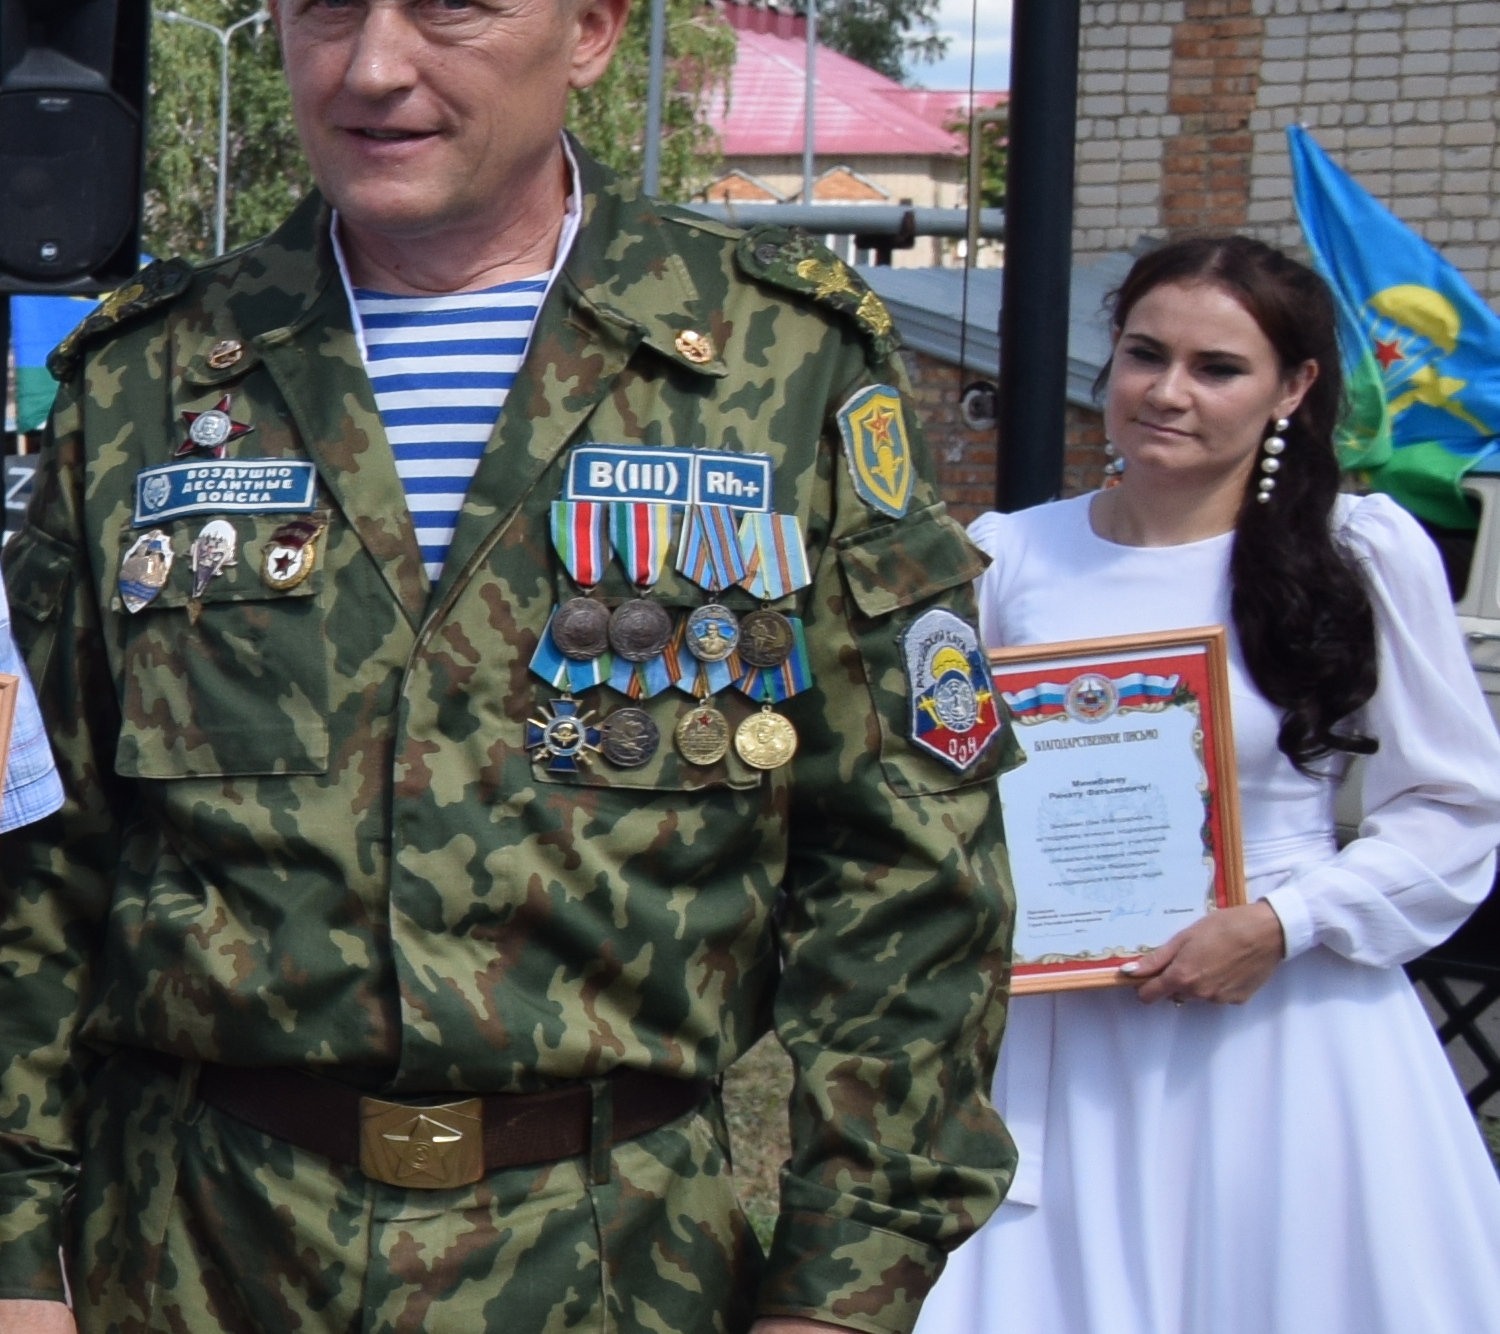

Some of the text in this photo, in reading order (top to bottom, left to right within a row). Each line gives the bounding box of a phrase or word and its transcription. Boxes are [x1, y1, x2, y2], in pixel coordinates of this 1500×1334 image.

[186, 467, 292, 480] ВОЗДУШНО
[588, 460, 760, 498] B(III) Rh+
[181, 479, 294, 494] ДЕСАНТНЫЕ
[196, 490, 271, 503] ВОЙСКА
[949, 736, 977, 762] ООН
